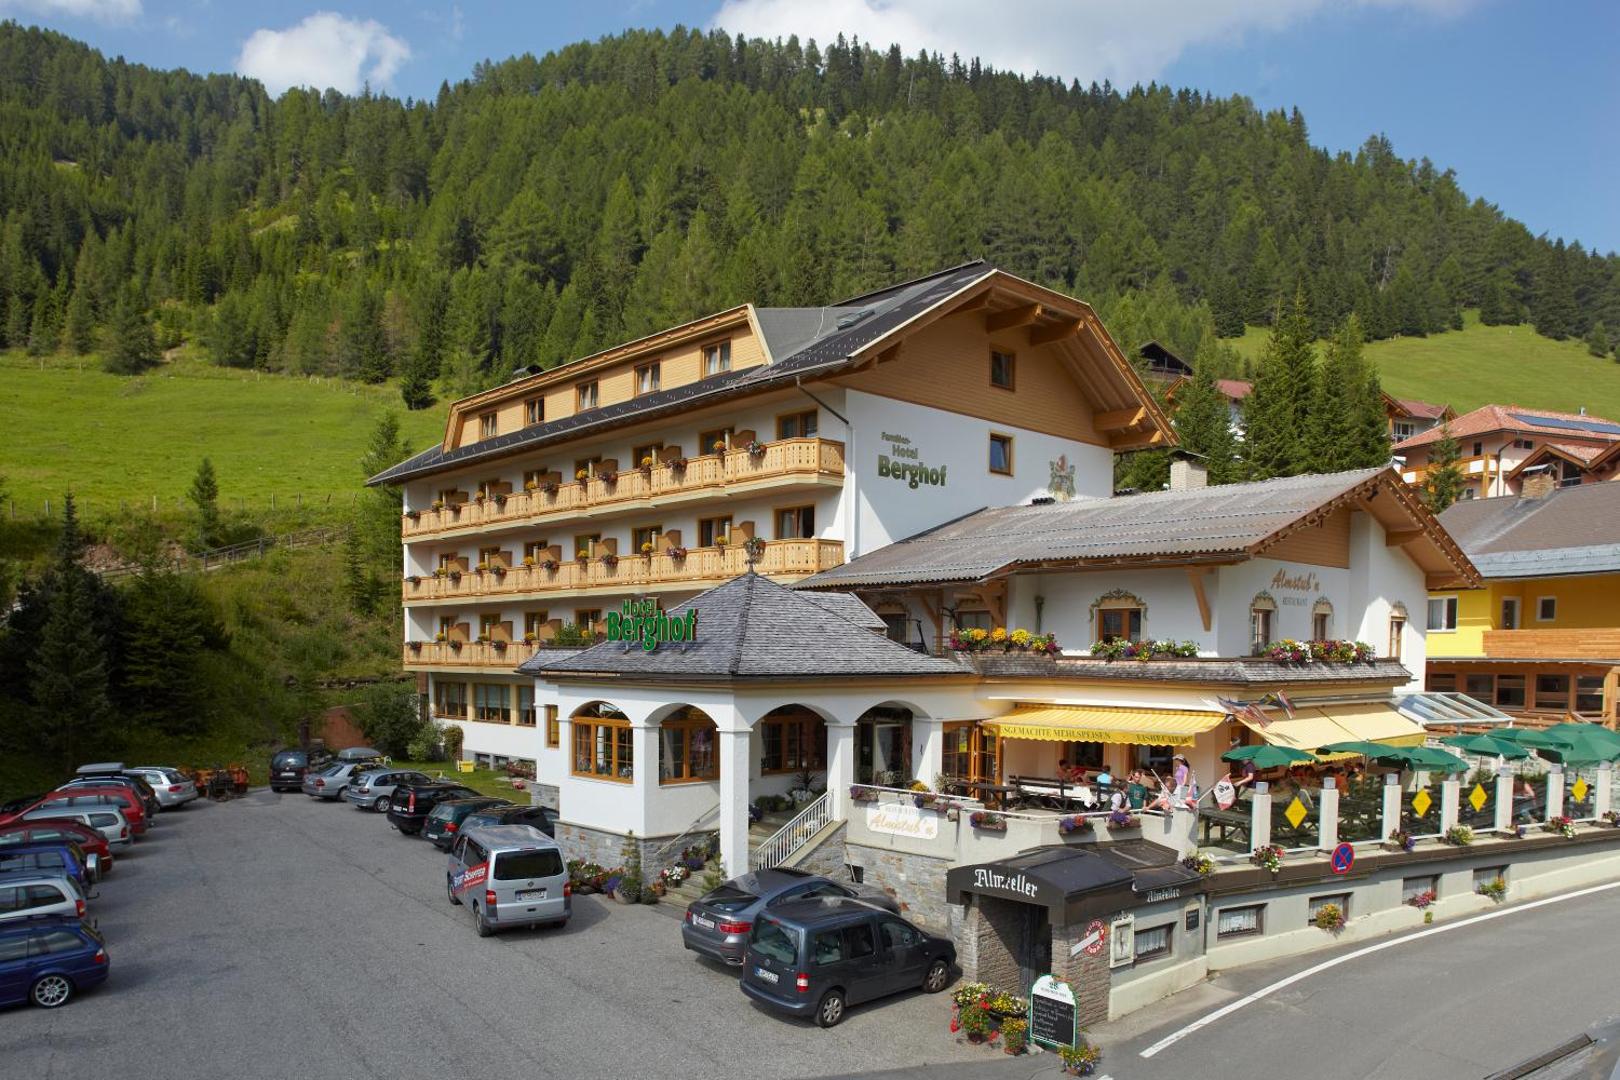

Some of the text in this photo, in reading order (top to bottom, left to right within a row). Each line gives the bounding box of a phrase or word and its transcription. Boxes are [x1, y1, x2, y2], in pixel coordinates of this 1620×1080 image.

[892, 443, 918, 459] Hotel
[878, 454, 947, 489] Berghof
[622, 597, 658, 616] Hotel
[607, 608, 695, 651] Berghof
